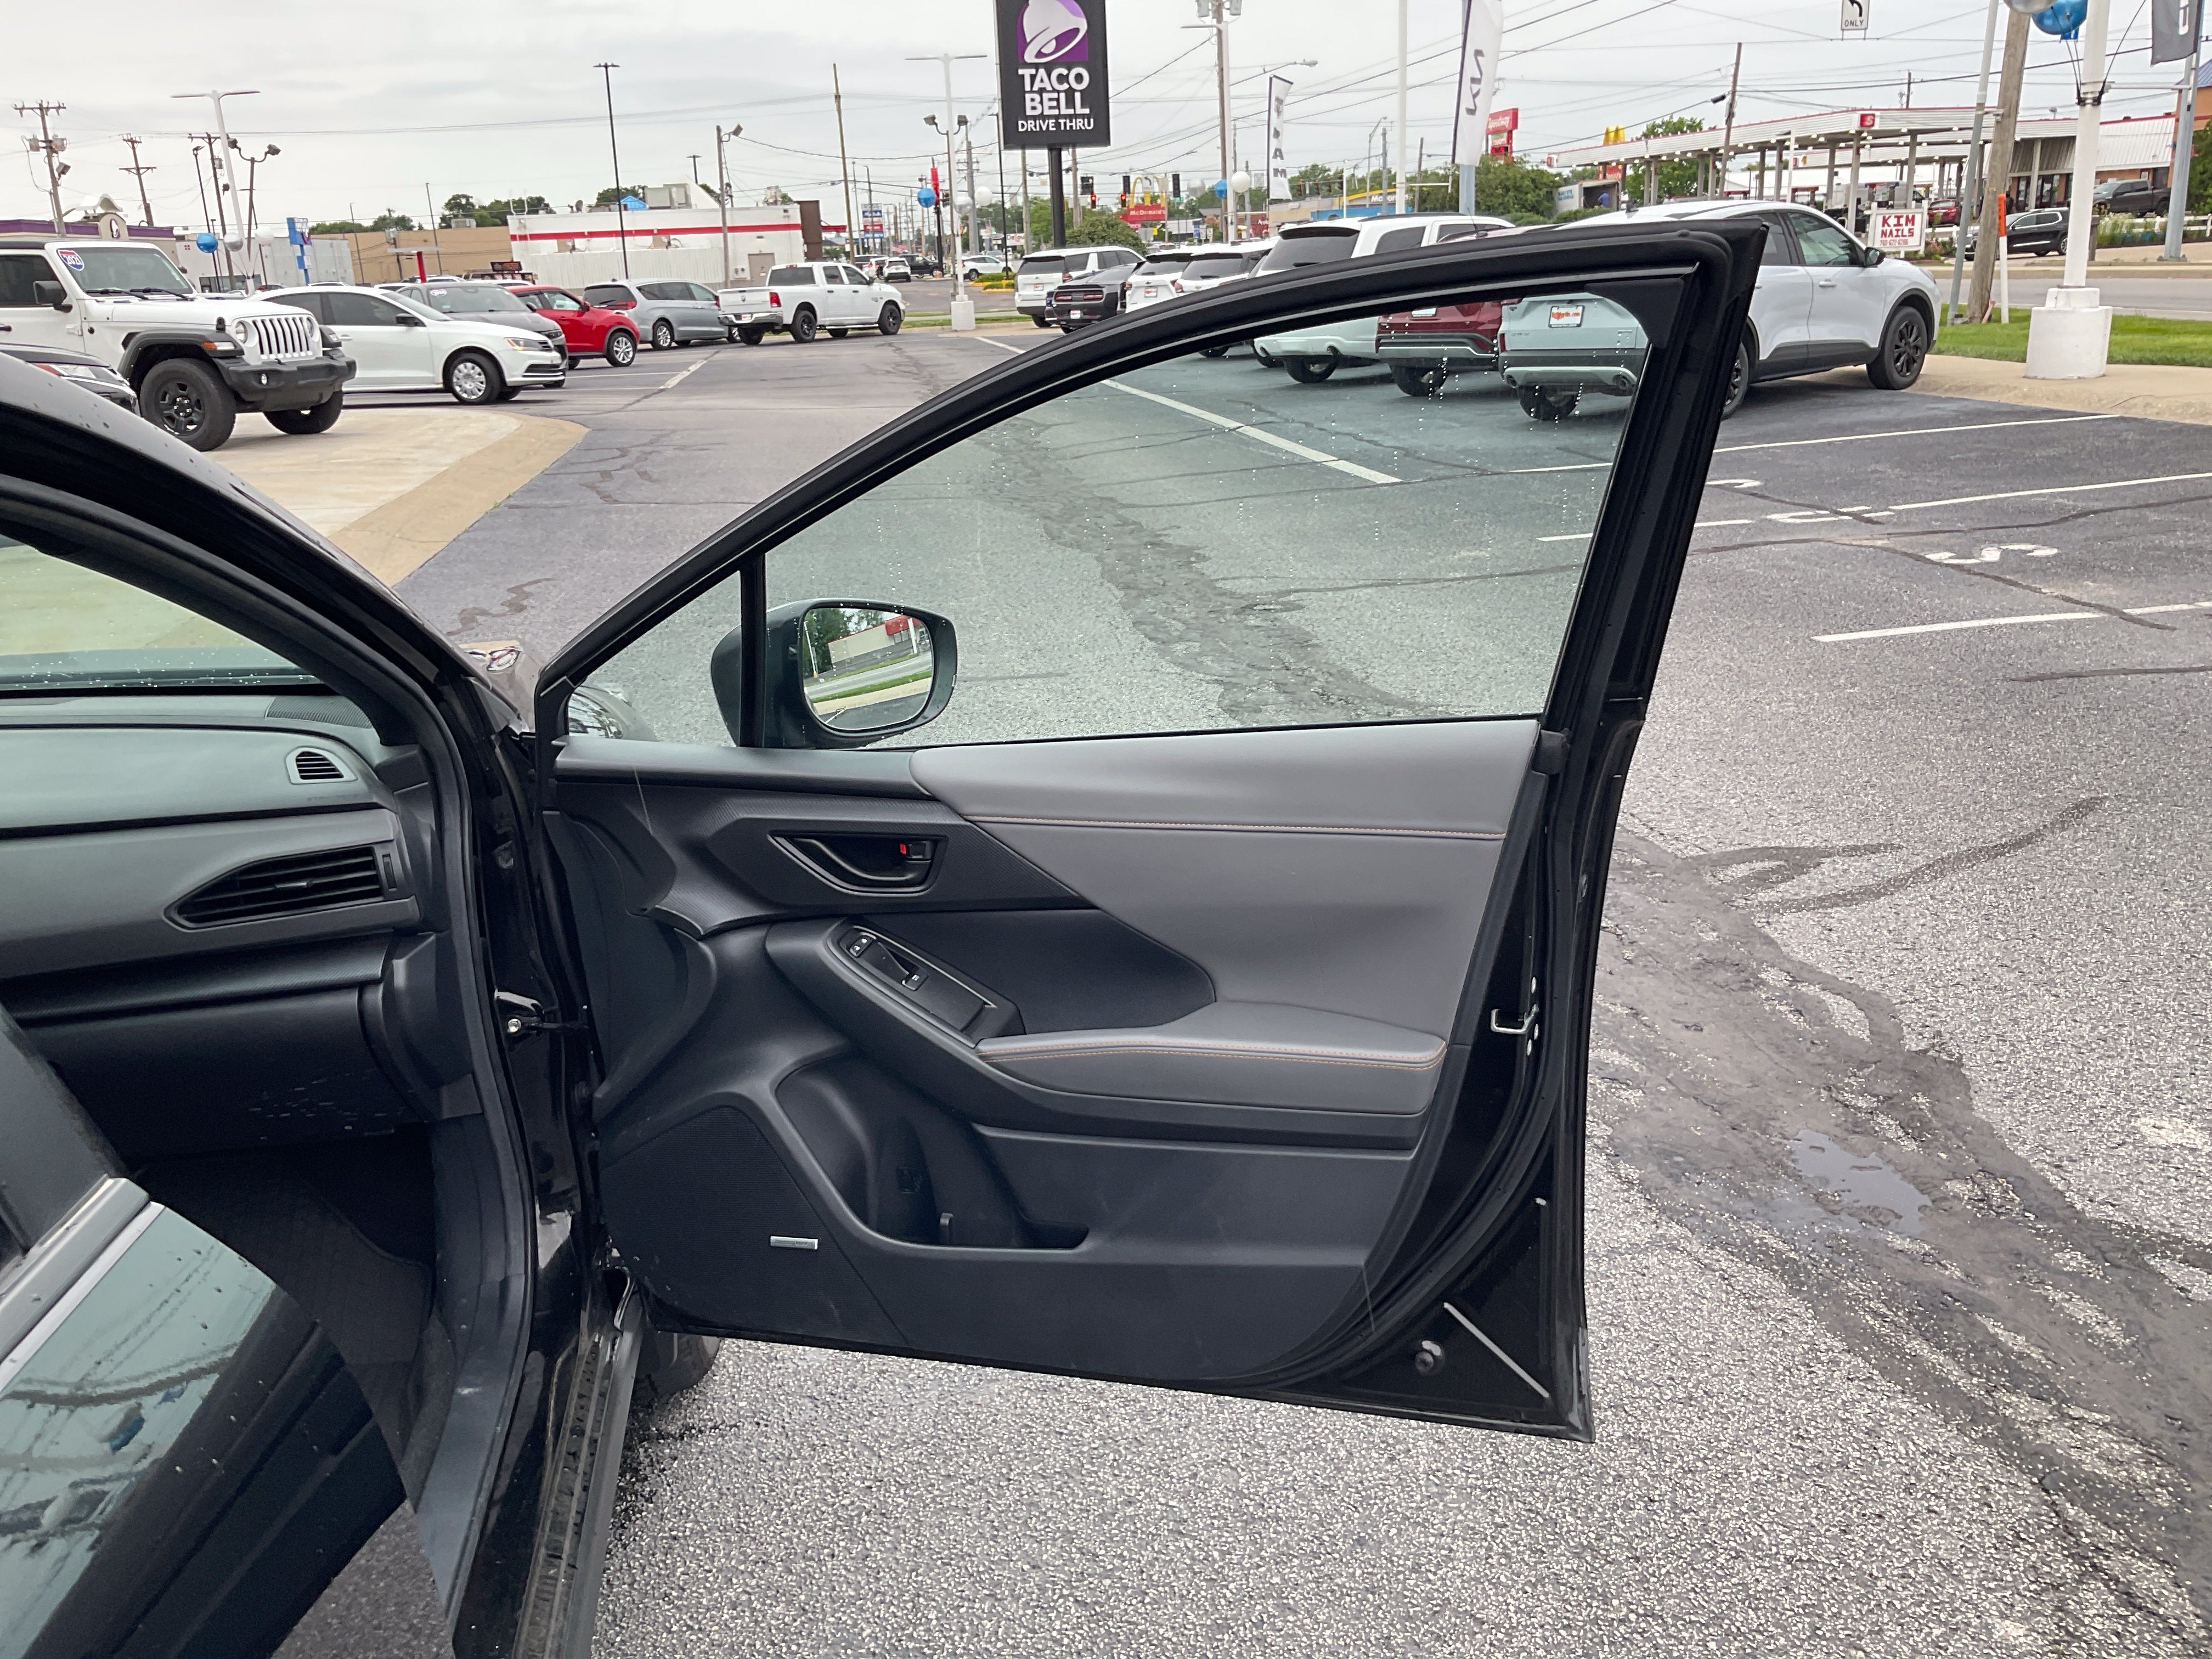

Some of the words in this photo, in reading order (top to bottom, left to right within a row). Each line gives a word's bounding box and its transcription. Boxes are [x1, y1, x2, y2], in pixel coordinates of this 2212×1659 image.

[1018, 67, 1090, 91] TACO
[1025, 92, 1090, 116] BELL
[1018, 119, 1057, 132] DRIVE
[1058, 118, 1094, 131] THRU
[1882, 214, 1916, 227] KIM
[1881, 228, 1915, 238] NAILS
